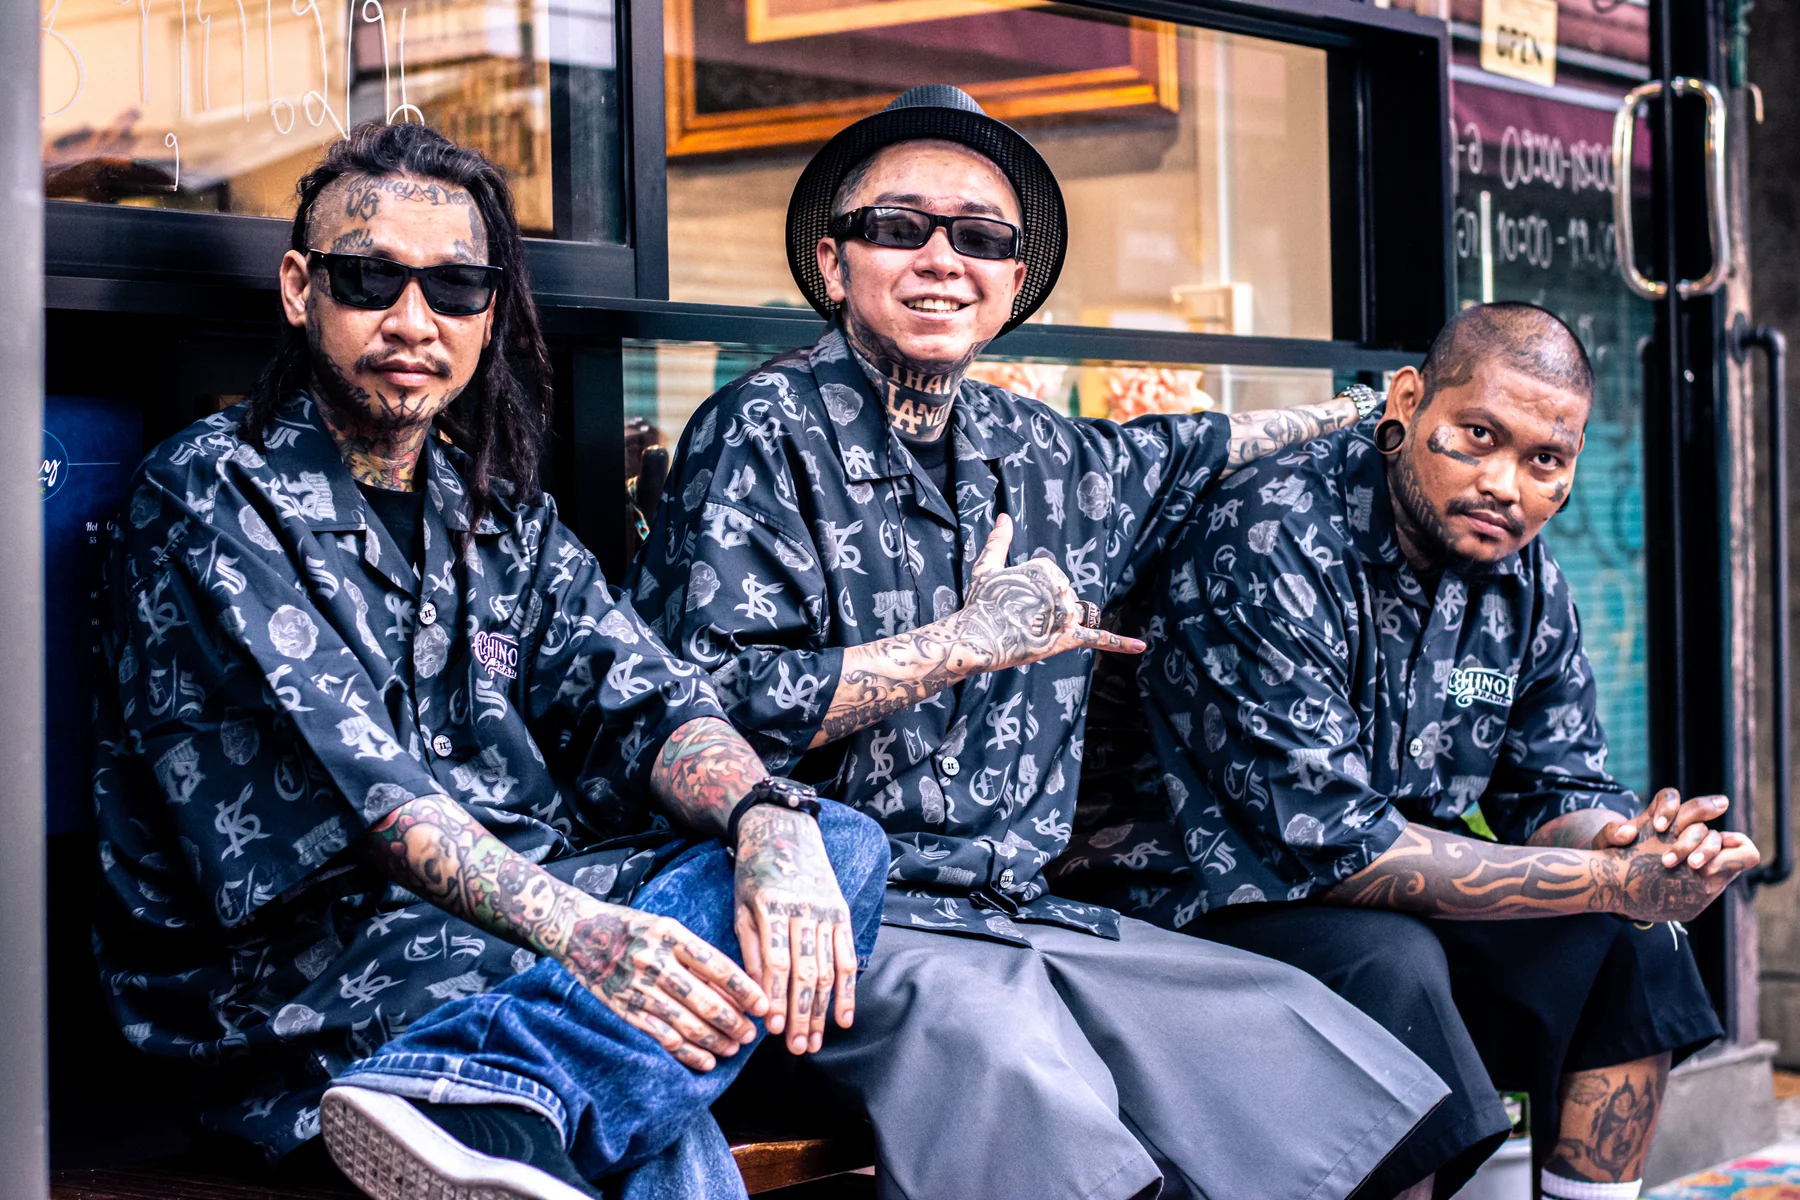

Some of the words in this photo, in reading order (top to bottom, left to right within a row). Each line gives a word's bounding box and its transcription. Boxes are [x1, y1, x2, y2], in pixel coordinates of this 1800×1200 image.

[1497, 26, 1543, 66] OPEN
[85, 521, 98, 532] Hot
[471, 630, 519, 667] CHINO
